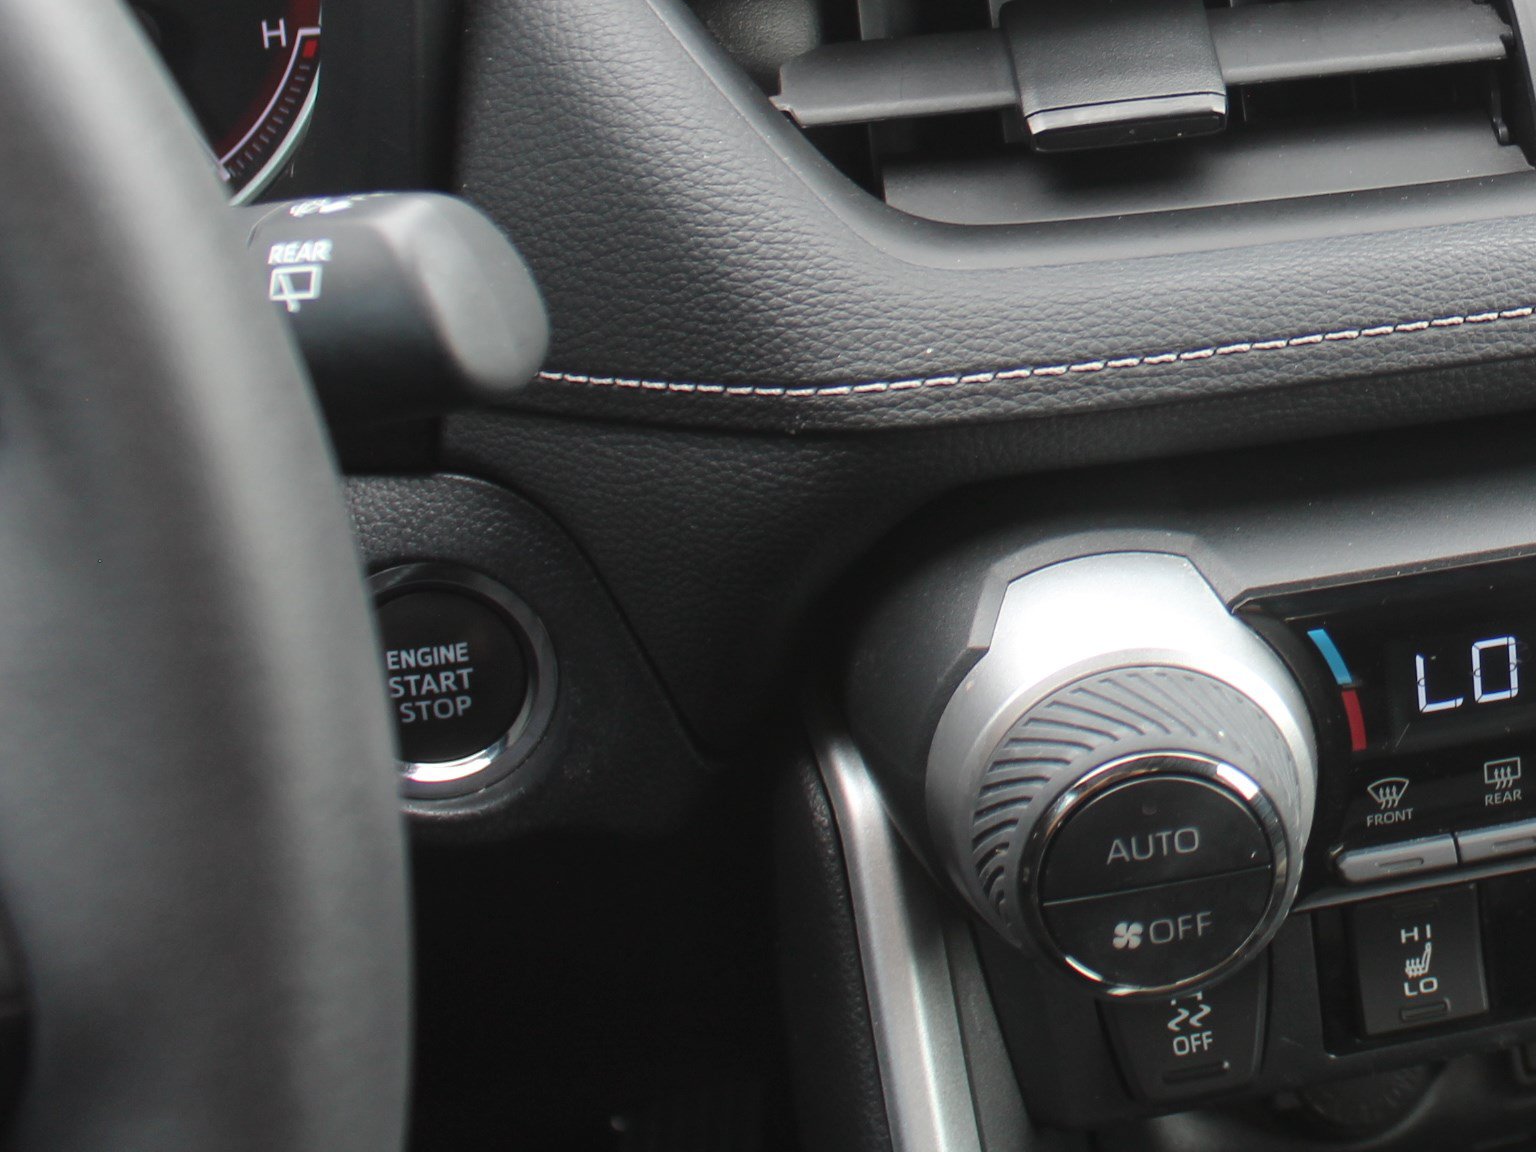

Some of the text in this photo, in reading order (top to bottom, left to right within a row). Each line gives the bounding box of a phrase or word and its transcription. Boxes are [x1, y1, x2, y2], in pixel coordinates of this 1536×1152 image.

[261, 18, 287, 49] H
[268, 239, 334, 265] REAR
[386, 642, 469, 671] ENGINE
[389, 668, 474, 698] START
[1415, 636, 1519, 713] LO
[400, 696, 472, 724] STOP
[1484, 788, 1522, 807] REAR
[1366, 808, 1414, 827] FRONT
[1106, 827, 1200, 865] AUTO
[1149, 911, 1212, 945] OFF
[1400, 924, 1431, 944] HI
[1404, 977, 1438, 997] LO
[1173, 1031, 1214, 1057] OFF
